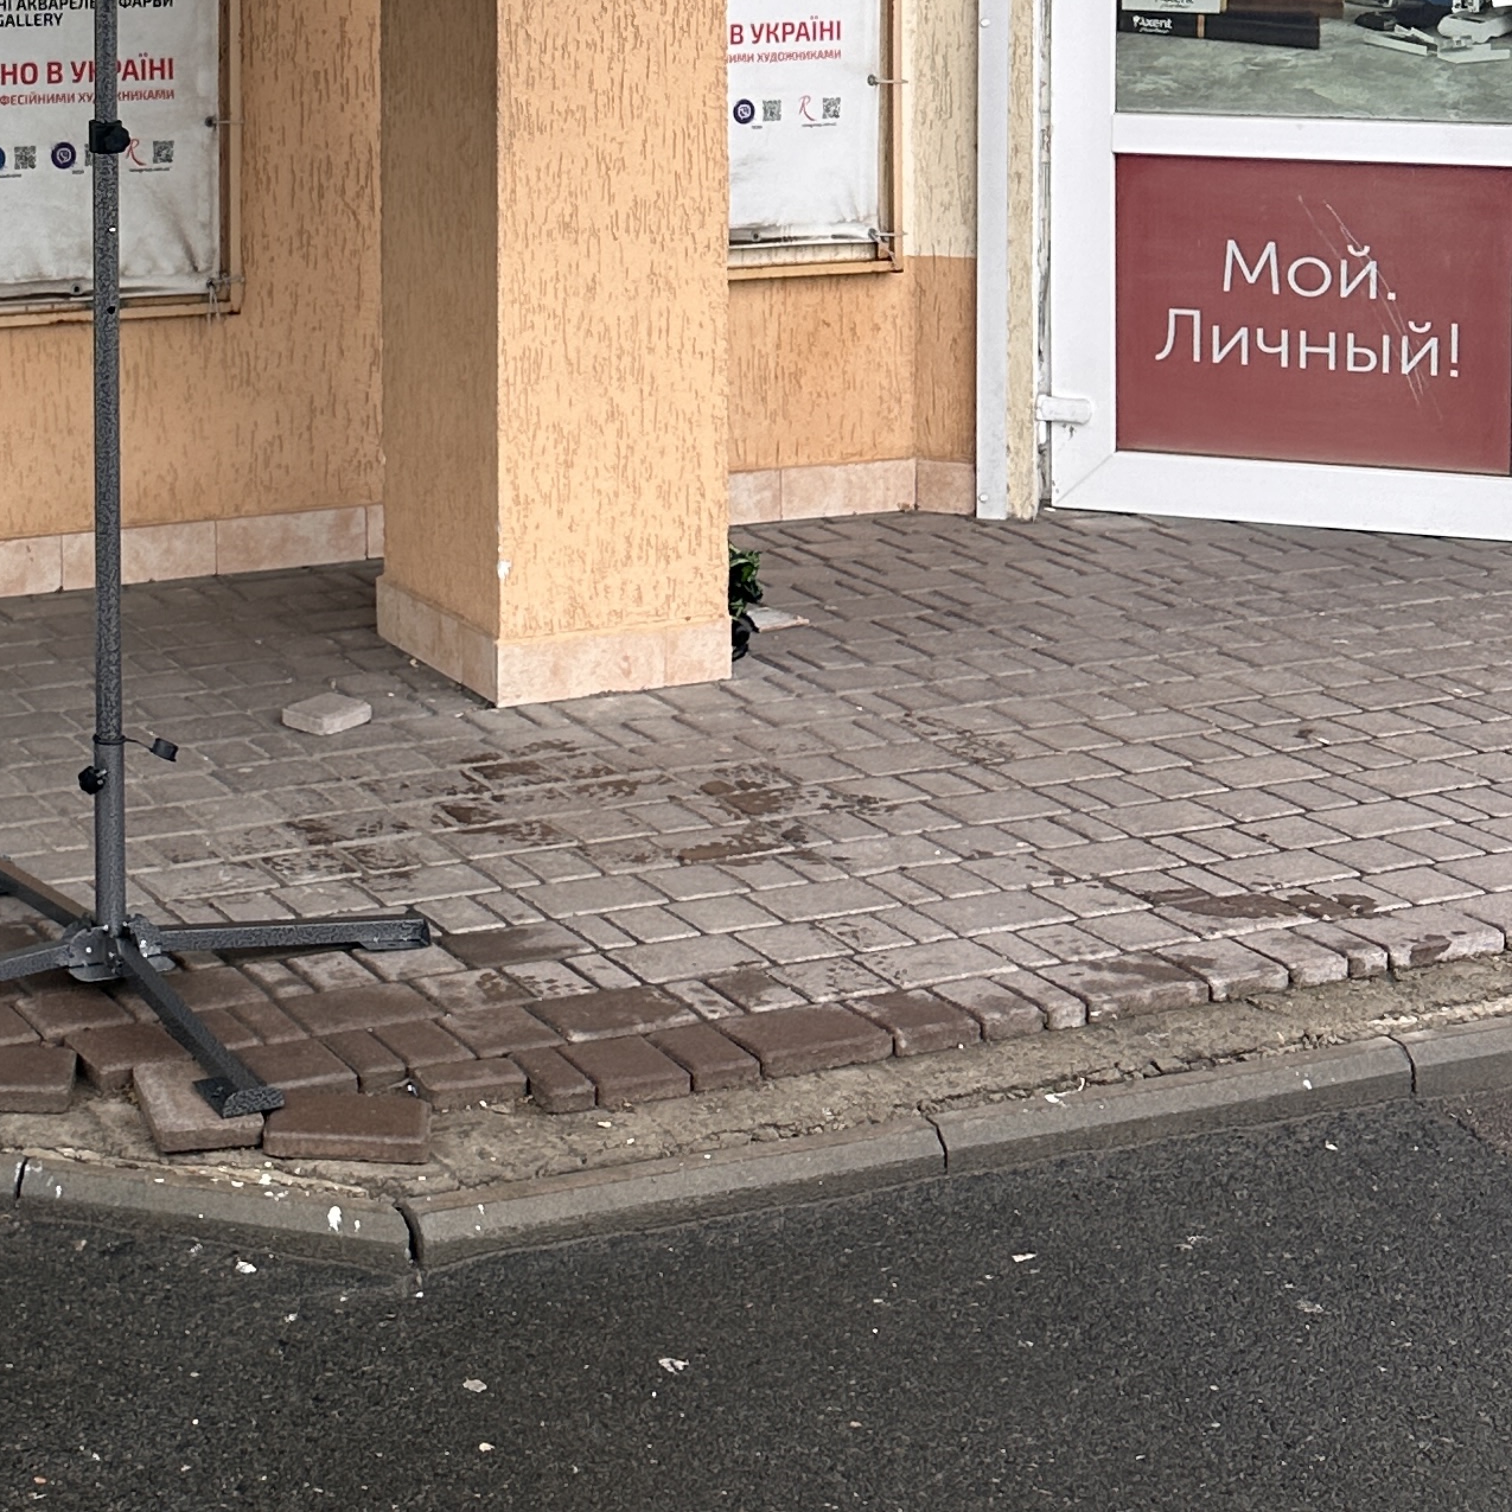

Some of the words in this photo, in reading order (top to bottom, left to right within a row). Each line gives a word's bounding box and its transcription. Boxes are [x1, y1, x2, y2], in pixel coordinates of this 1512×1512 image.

[730, 23, 744, 45] В
[750, 15, 841, 44] УКРАЇНІ
[1138, 16, 1174, 30] Axent
[756, 49, 842, 63] ХУДОЖНИКАМИ
[46, 61, 64, 84] В
[78, 89, 175, 104] ХУНИКАМИ
[1223, 239, 1397, 301] Мой.
[1155, 308, 1459, 378] Личный!
